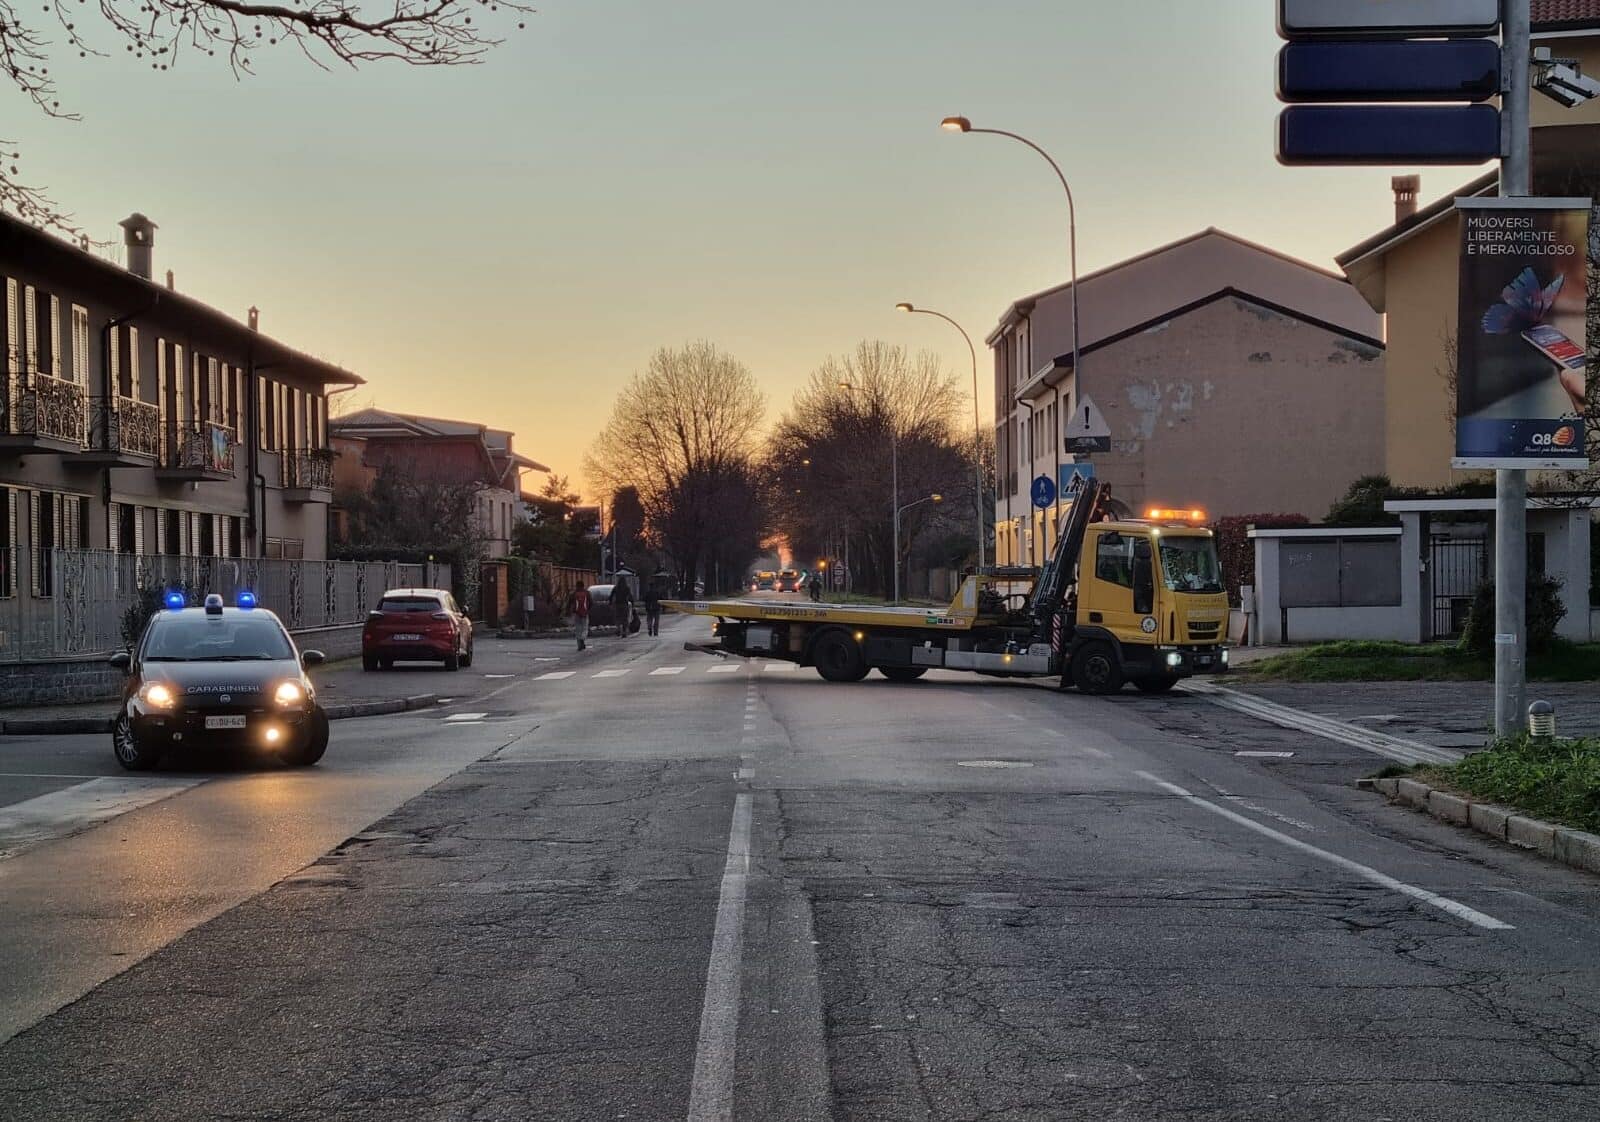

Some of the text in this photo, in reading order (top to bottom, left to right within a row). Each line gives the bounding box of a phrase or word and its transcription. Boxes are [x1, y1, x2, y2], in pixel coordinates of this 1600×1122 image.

[1468, 217, 1534, 228] MUOVERSI
[1467, 231, 1557, 242] LIBERAMENTE
[1467, 243, 1575, 255] È MERAVIGLIOSO
[1532, 433, 1552, 446] Q8
[187, 685, 260, 694] CARABINIERI
